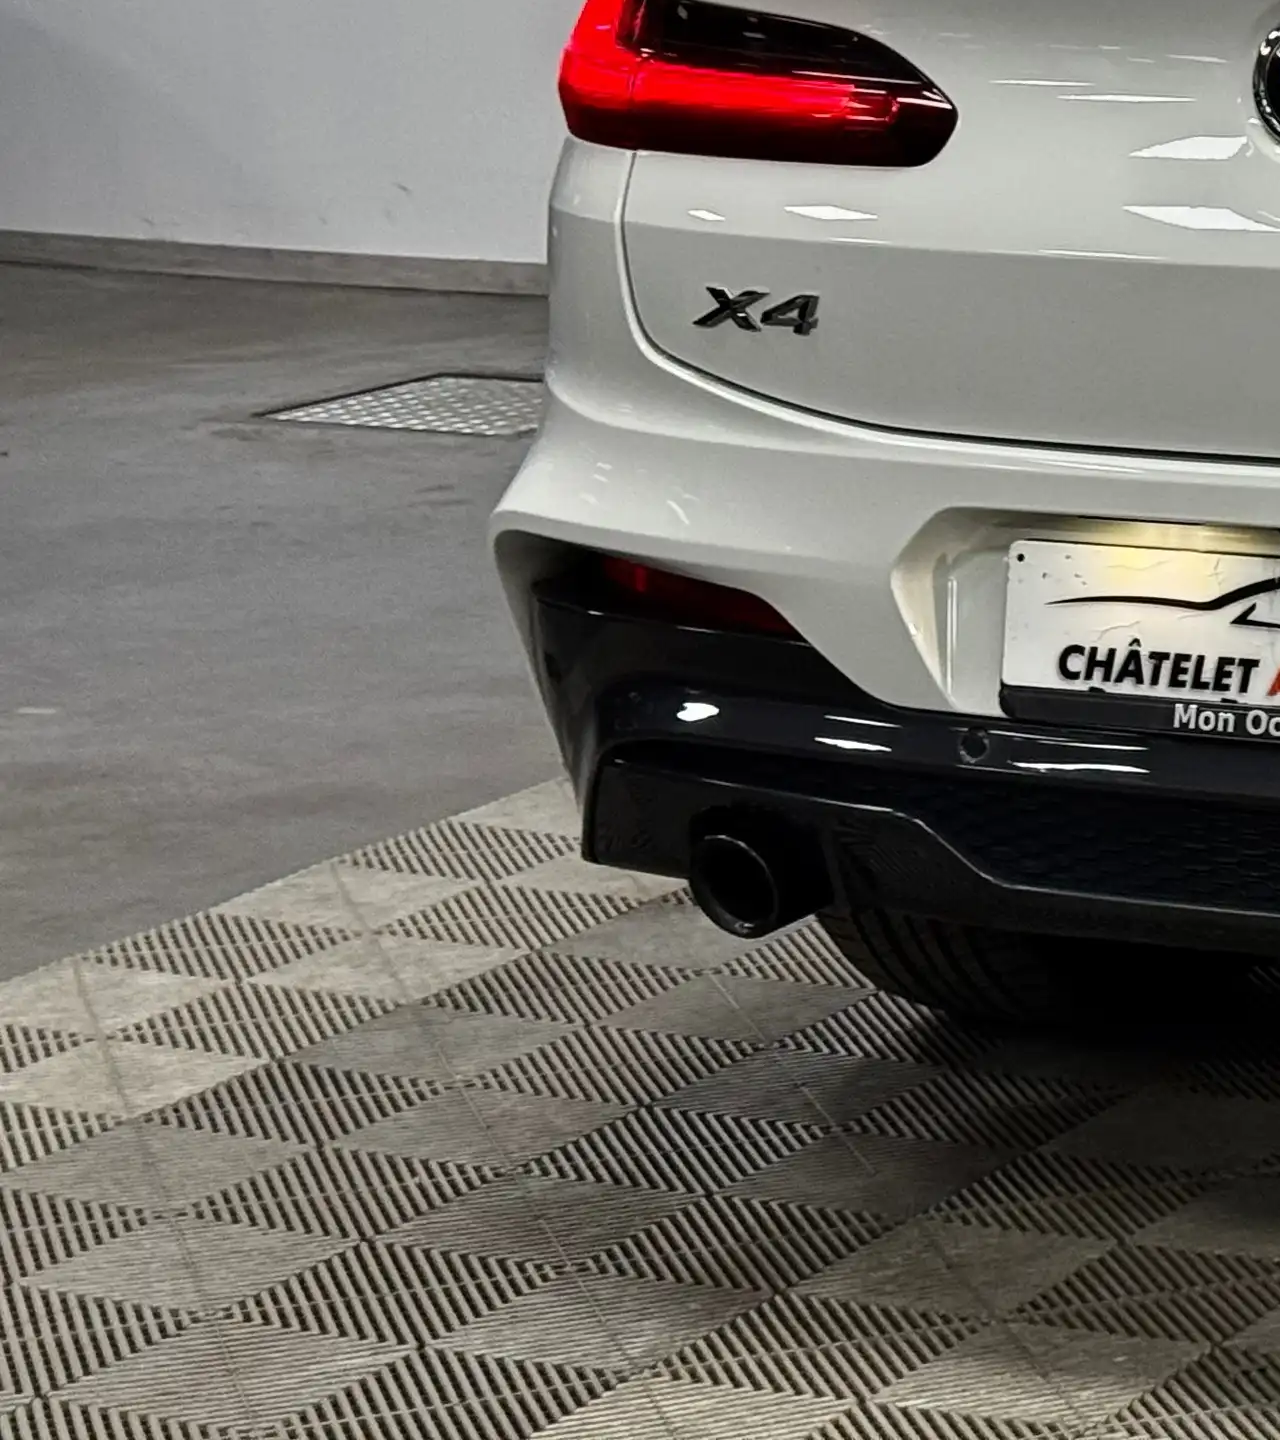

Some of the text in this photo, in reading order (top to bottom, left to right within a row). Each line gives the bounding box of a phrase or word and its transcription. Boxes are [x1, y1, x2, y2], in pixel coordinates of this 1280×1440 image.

[692, 284, 820, 336] X4
[1058, 637, 1260, 693] CHÂTELET
[1173, 703, 1235, 732] Mon
